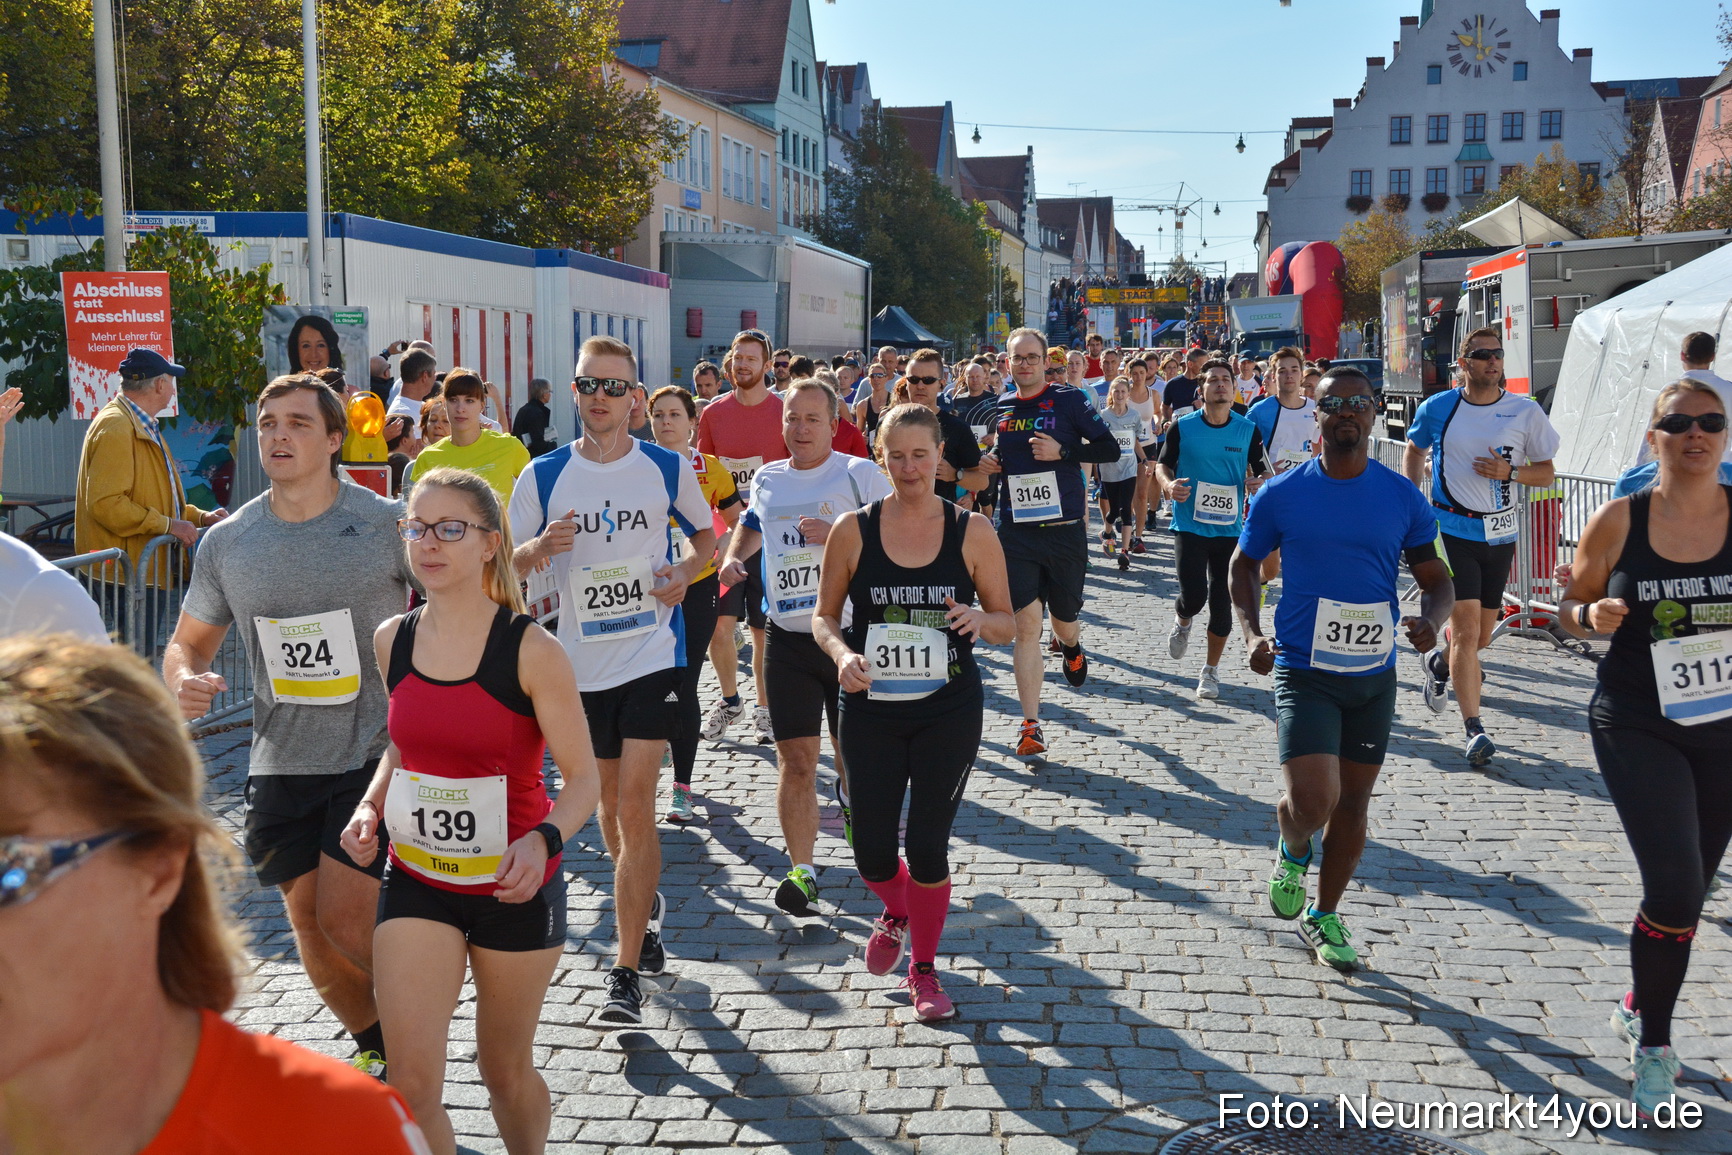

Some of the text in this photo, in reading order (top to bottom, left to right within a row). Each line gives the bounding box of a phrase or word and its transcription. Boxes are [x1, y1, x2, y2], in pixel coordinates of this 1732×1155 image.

[73, 281, 163, 298] Abschluss
[1119, 290, 1155, 300] START
[73, 299, 103, 308] statt
[75, 309, 165, 323] Ausschluss!
[91, 331, 162, 342] Mehr Lehrer für
[88, 343, 126, 352] kleinere
[999, 417, 1056, 433] MENSCH
[1016, 485, 1051, 503] 3146
[1201, 494, 1233, 510] 2358
[1490, 513, 1516, 531] 2497
[784, 553, 812, 563] BOCK
[592, 566, 629, 579] BOCK
[777, 564, 820, 590] 3071
[584, 579, 643, 610] 2394
[870, 586, 956, 605] ICH WERDE NICHT
[1637, 574, 1732, 601] ICH WERDE NIC
[1341, 609, 1375, 618] BOCK
[280, 622, 323, 635] BOCK
[600, 617, 639, 632] Dominik
[888, 630, 923, 640] BOCK
[1326, 621, 1383, 645] 3122
[281, 639, 333, 668] 324
[1682, 640, 1723, 654] BOCK
[876, 645, 930, 668] 3111
[1671, 655, 1732, 690] 3112
[418, 785, 469, 800] BOCK
[411, 808, 476, 842] 139
[412, 838, 433, 851] PARTL
[431, 857, 459, 873] Tina
